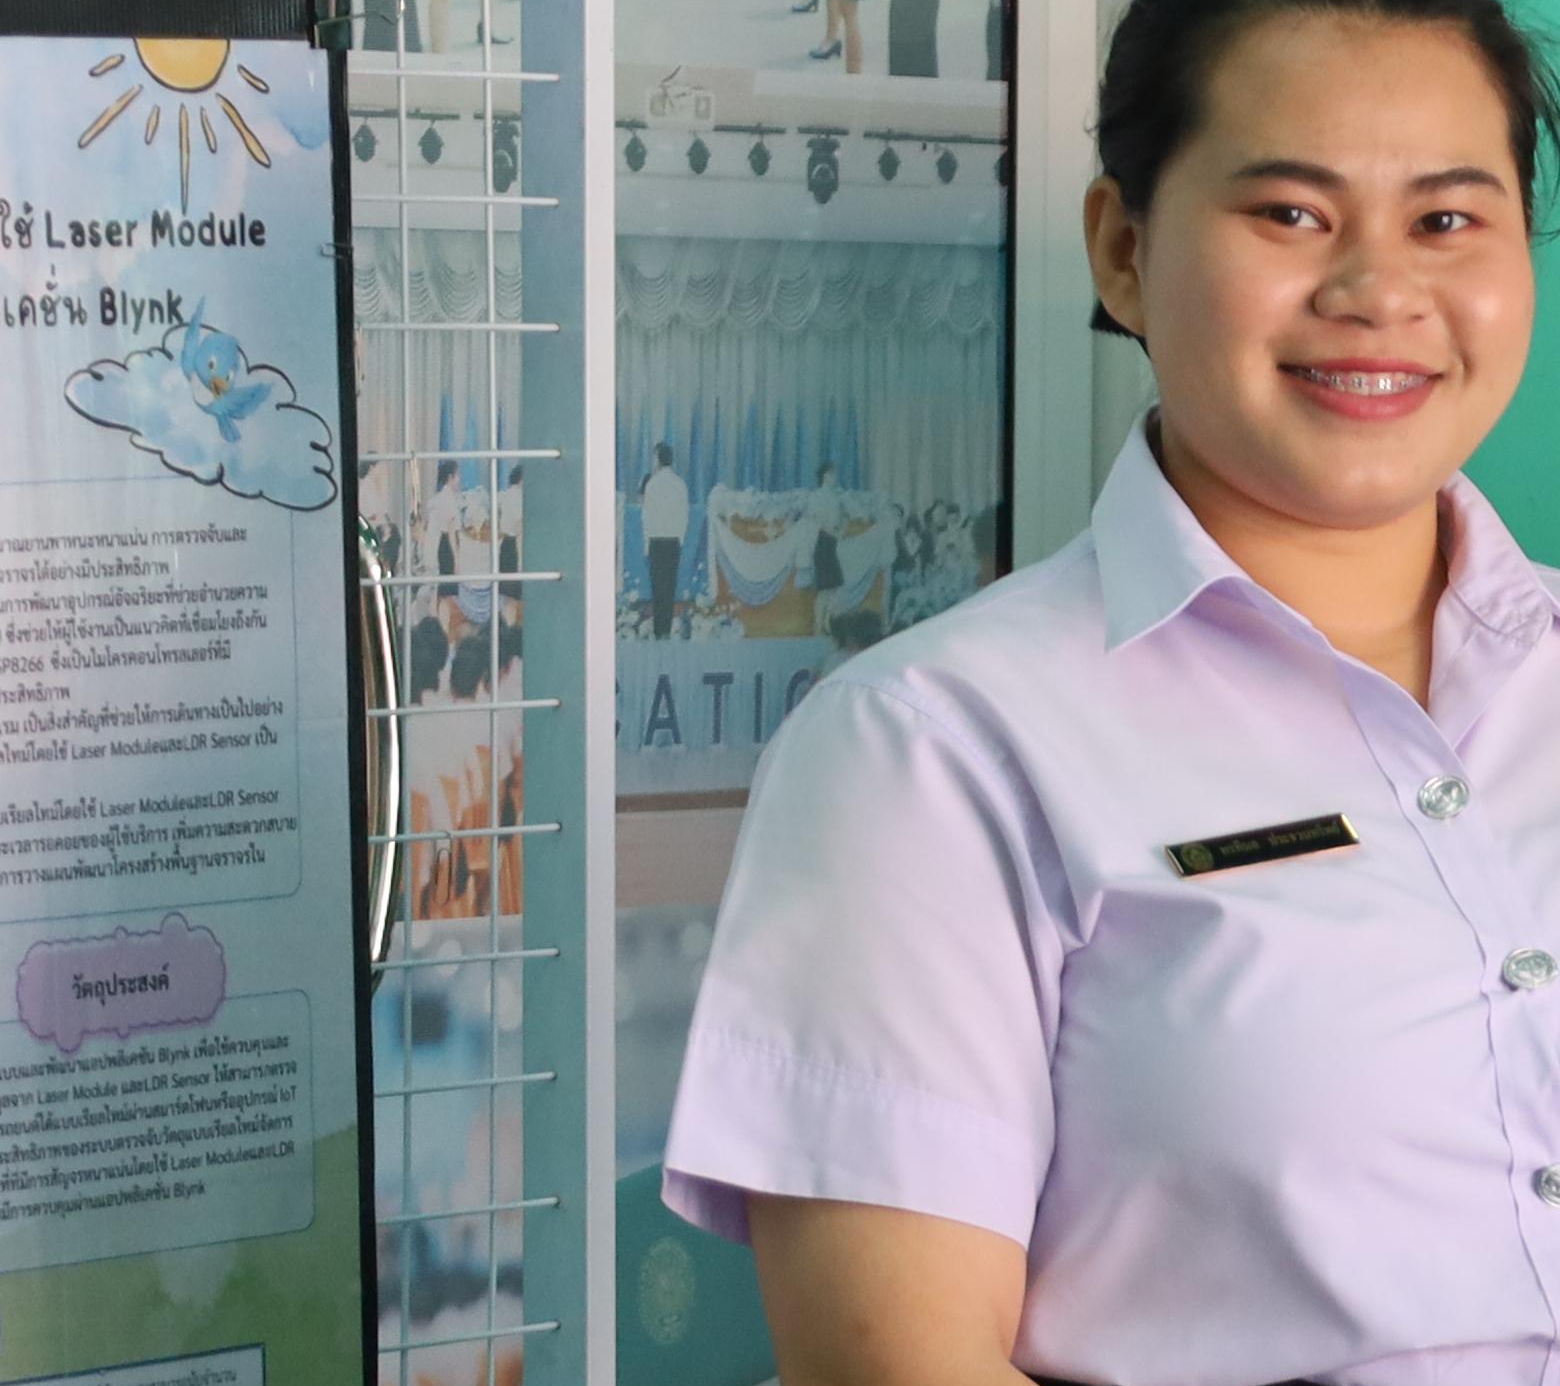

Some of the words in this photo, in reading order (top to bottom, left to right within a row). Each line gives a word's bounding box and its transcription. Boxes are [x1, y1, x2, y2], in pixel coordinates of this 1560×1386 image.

[46, 209, 138, 248] Laser
[152, 210, 266, 248] Module
[100, 287, 183, 335] Blynk
[152, 523, 247, 545] การตรวจจับและ
[72, 744, 106, 760] Laser
[212, 731, 250, 748] Sensor
[255, 724, 278, 746] เป็น
[101, 799, 135, 817] Laser
[238, 788, 279, 805] Sensor
[72, 963, 170, 1005] วัตถุประสงค์
[158, 1047, 191, 1064] Blynk
[171, 1156, 201, 1173] Laser
[174, 1180, 205, 1200] Blynk
